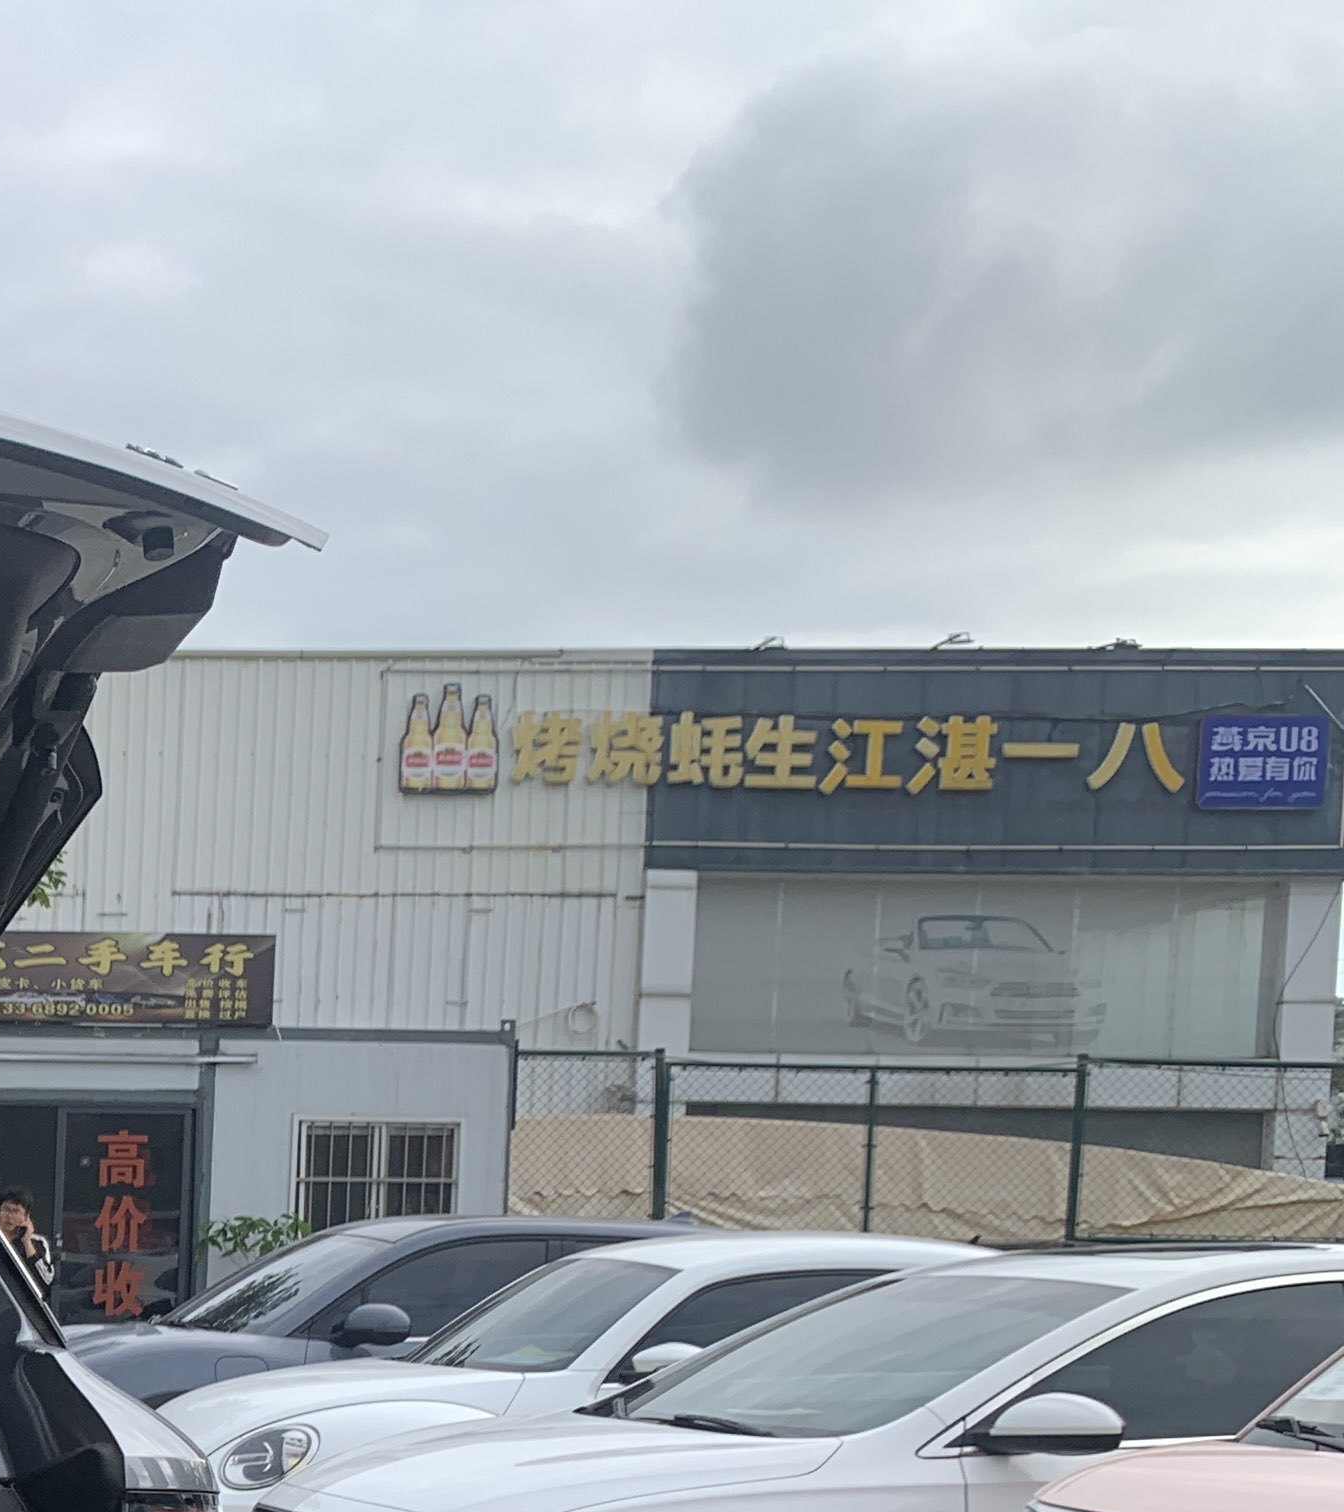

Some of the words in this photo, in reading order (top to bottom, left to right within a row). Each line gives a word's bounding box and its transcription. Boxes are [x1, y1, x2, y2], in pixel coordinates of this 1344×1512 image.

[1211, 726, 1319, 752] 燕京U8
[1209, 756, 1318, 782] 热爱有你
